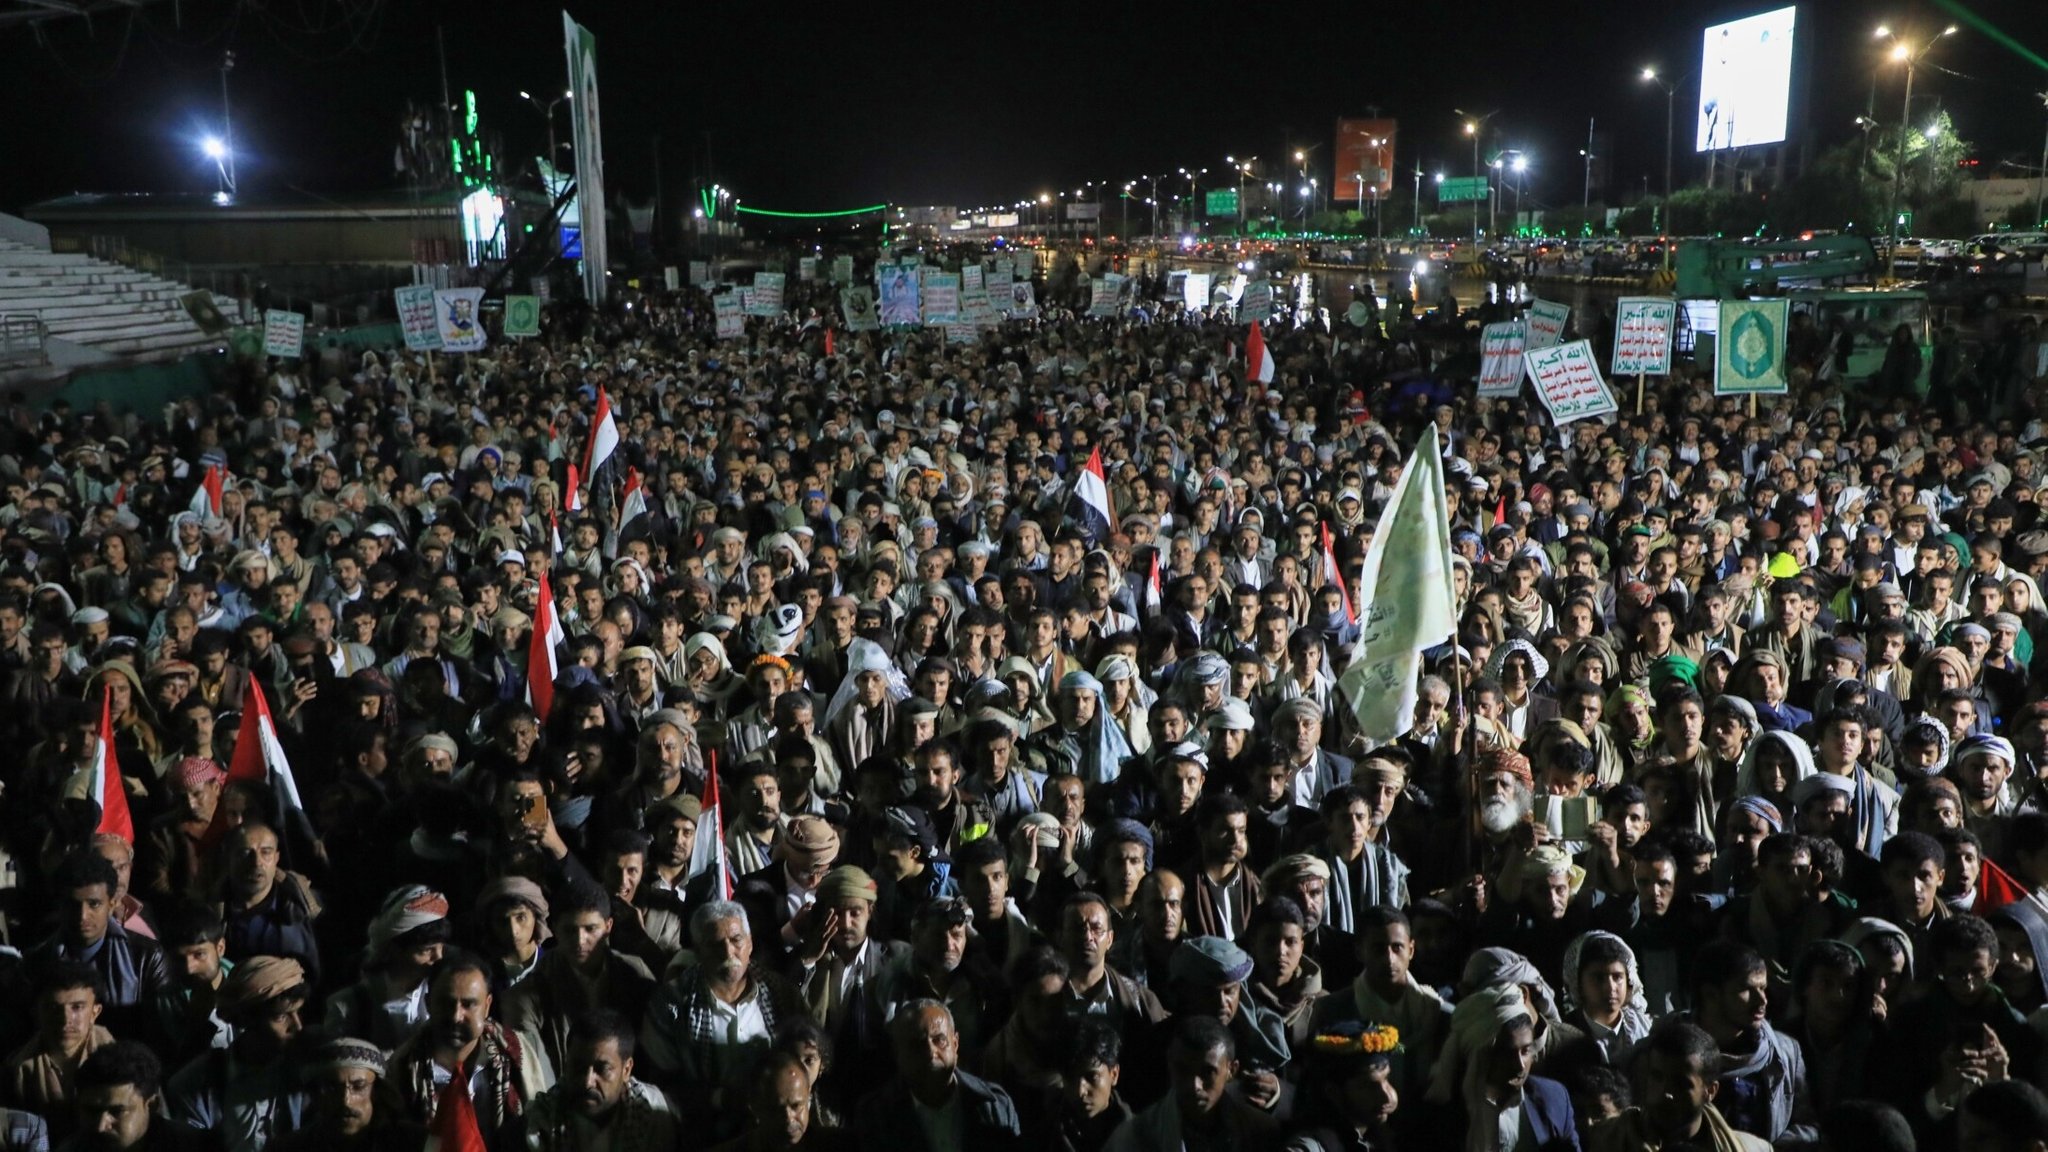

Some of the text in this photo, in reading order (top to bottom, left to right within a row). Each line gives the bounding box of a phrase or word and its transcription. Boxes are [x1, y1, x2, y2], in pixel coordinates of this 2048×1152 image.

[1652, 306, 1670, 318] الله
[1538, 346, 1585, 369] الله أكبر
[1585, 395, 1607, 410] النصر
